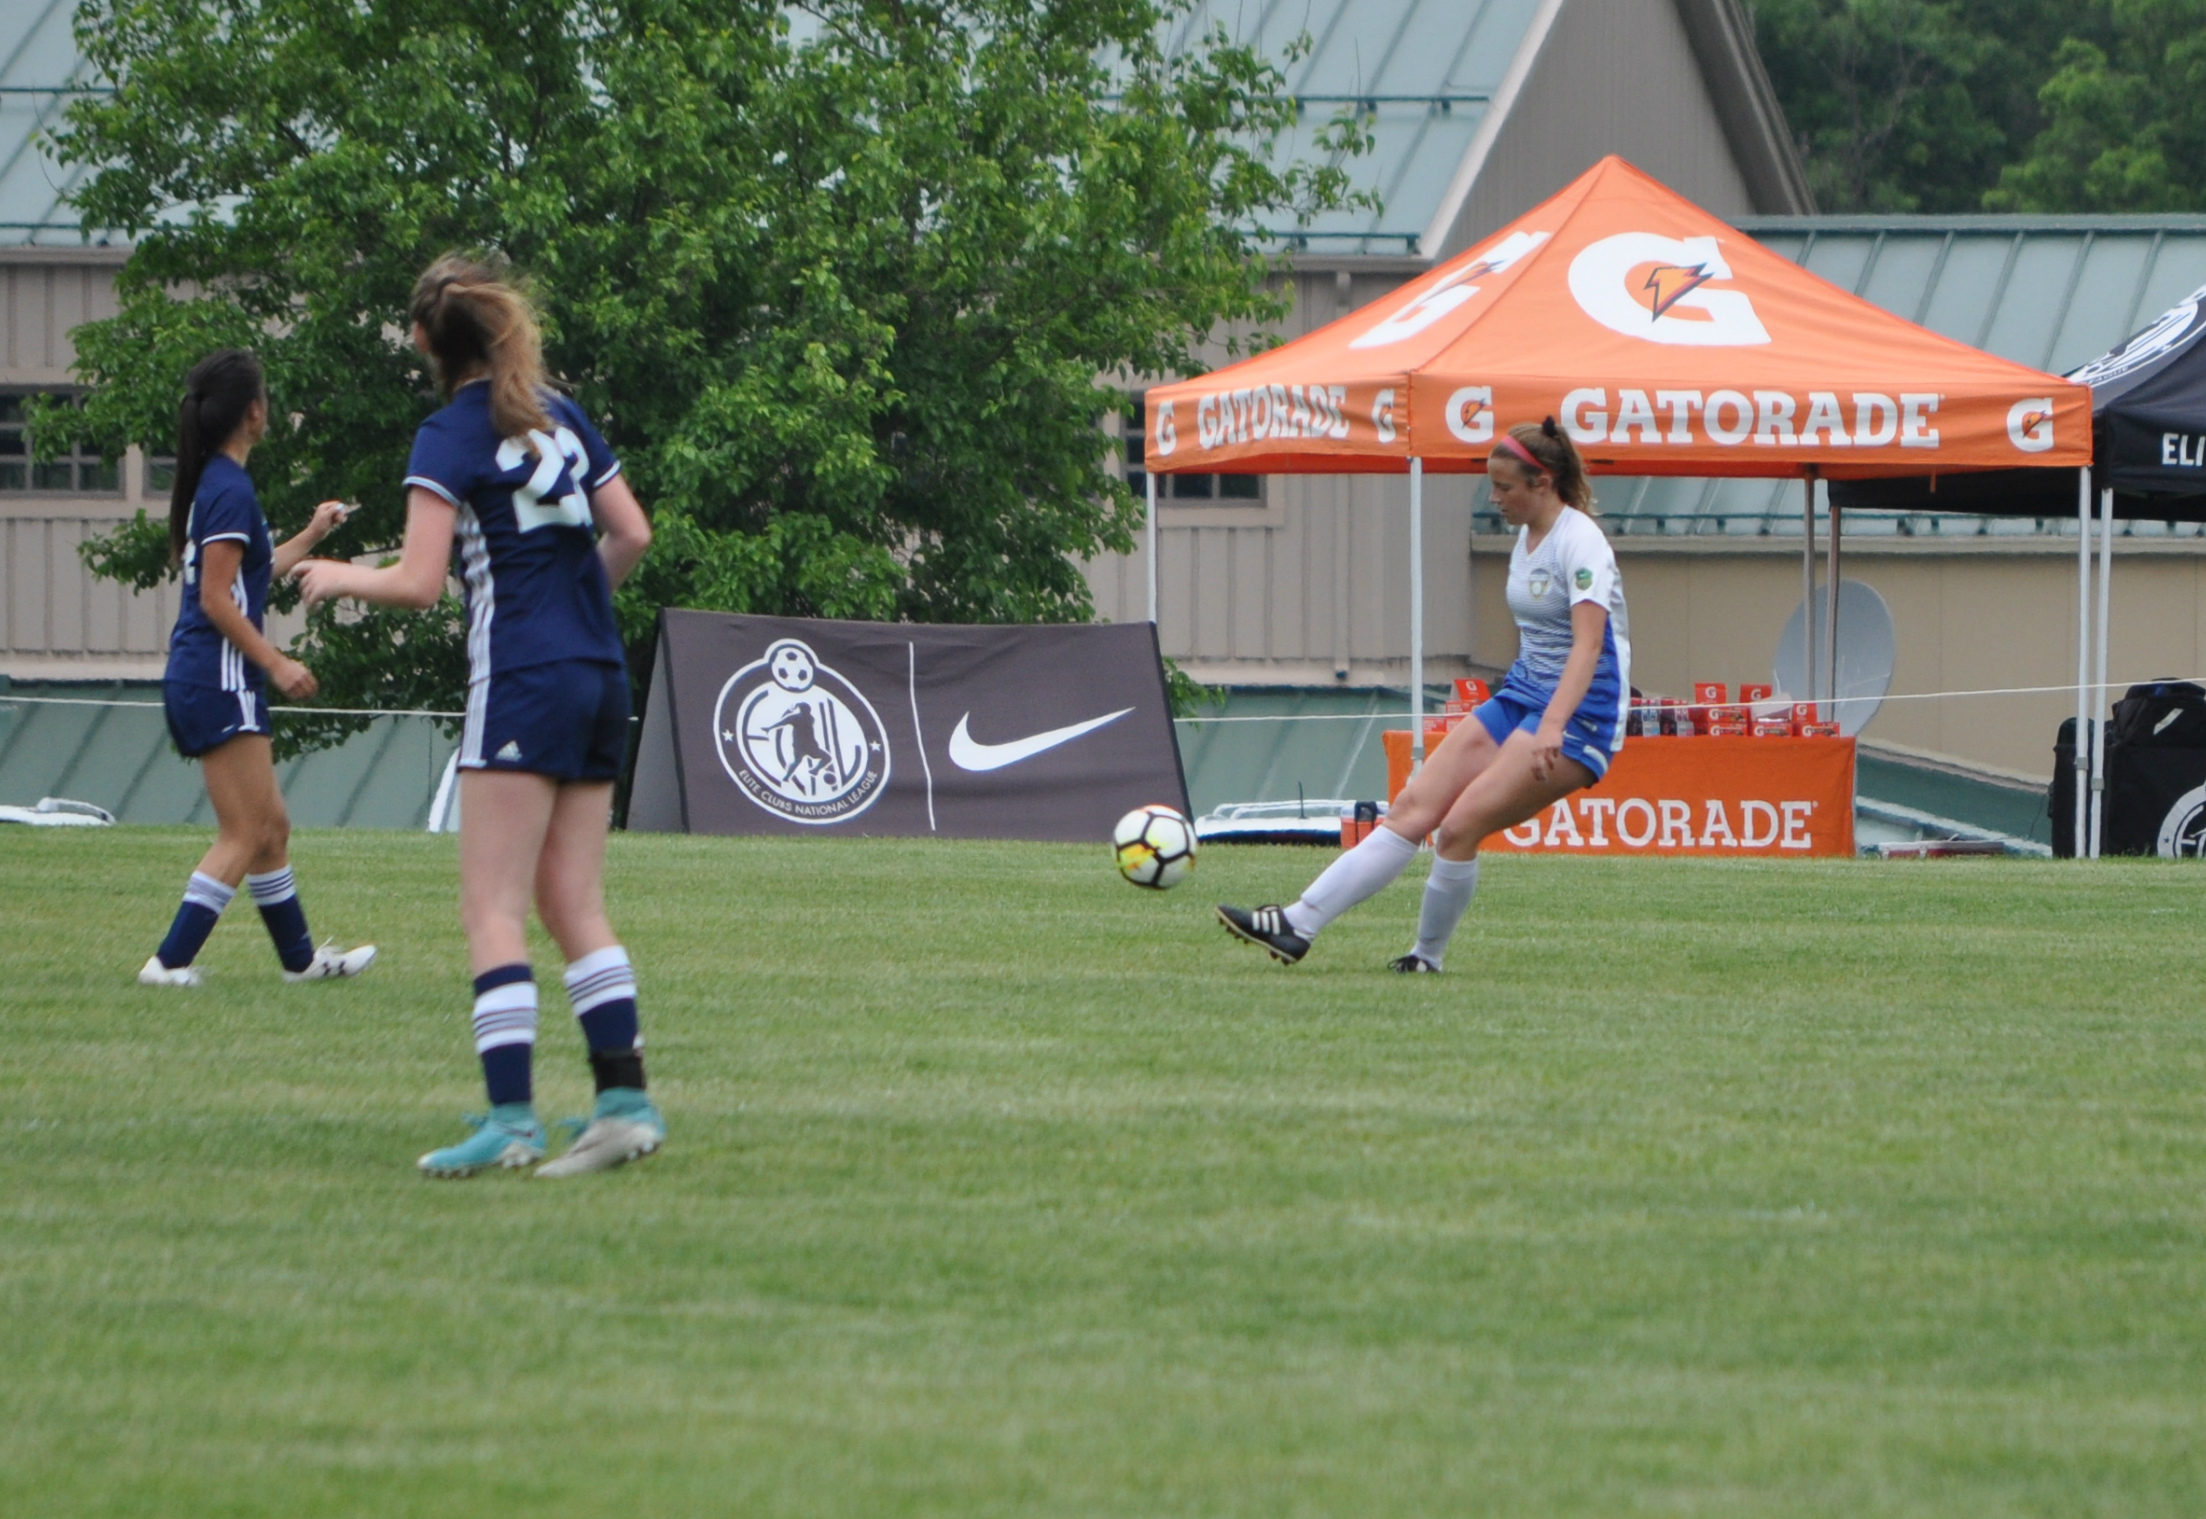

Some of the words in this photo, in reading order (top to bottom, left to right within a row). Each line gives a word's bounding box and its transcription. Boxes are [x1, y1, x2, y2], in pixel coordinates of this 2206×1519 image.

[1567, 231, 1772, 346] G
[1197, 384, 1350, 449] GATORADE
[1445, 386, 1495, 444] G
[1559, 388, 1940, 448] GATORADE
[2006, 398, 2054, 453] G
[738, 769, 761, 795] ELITE
[760, 790, 792, 812] CLUBS
[795, 800, 849, 816] NATIONAL
[849, 770, 878, 804] LEAGUE
